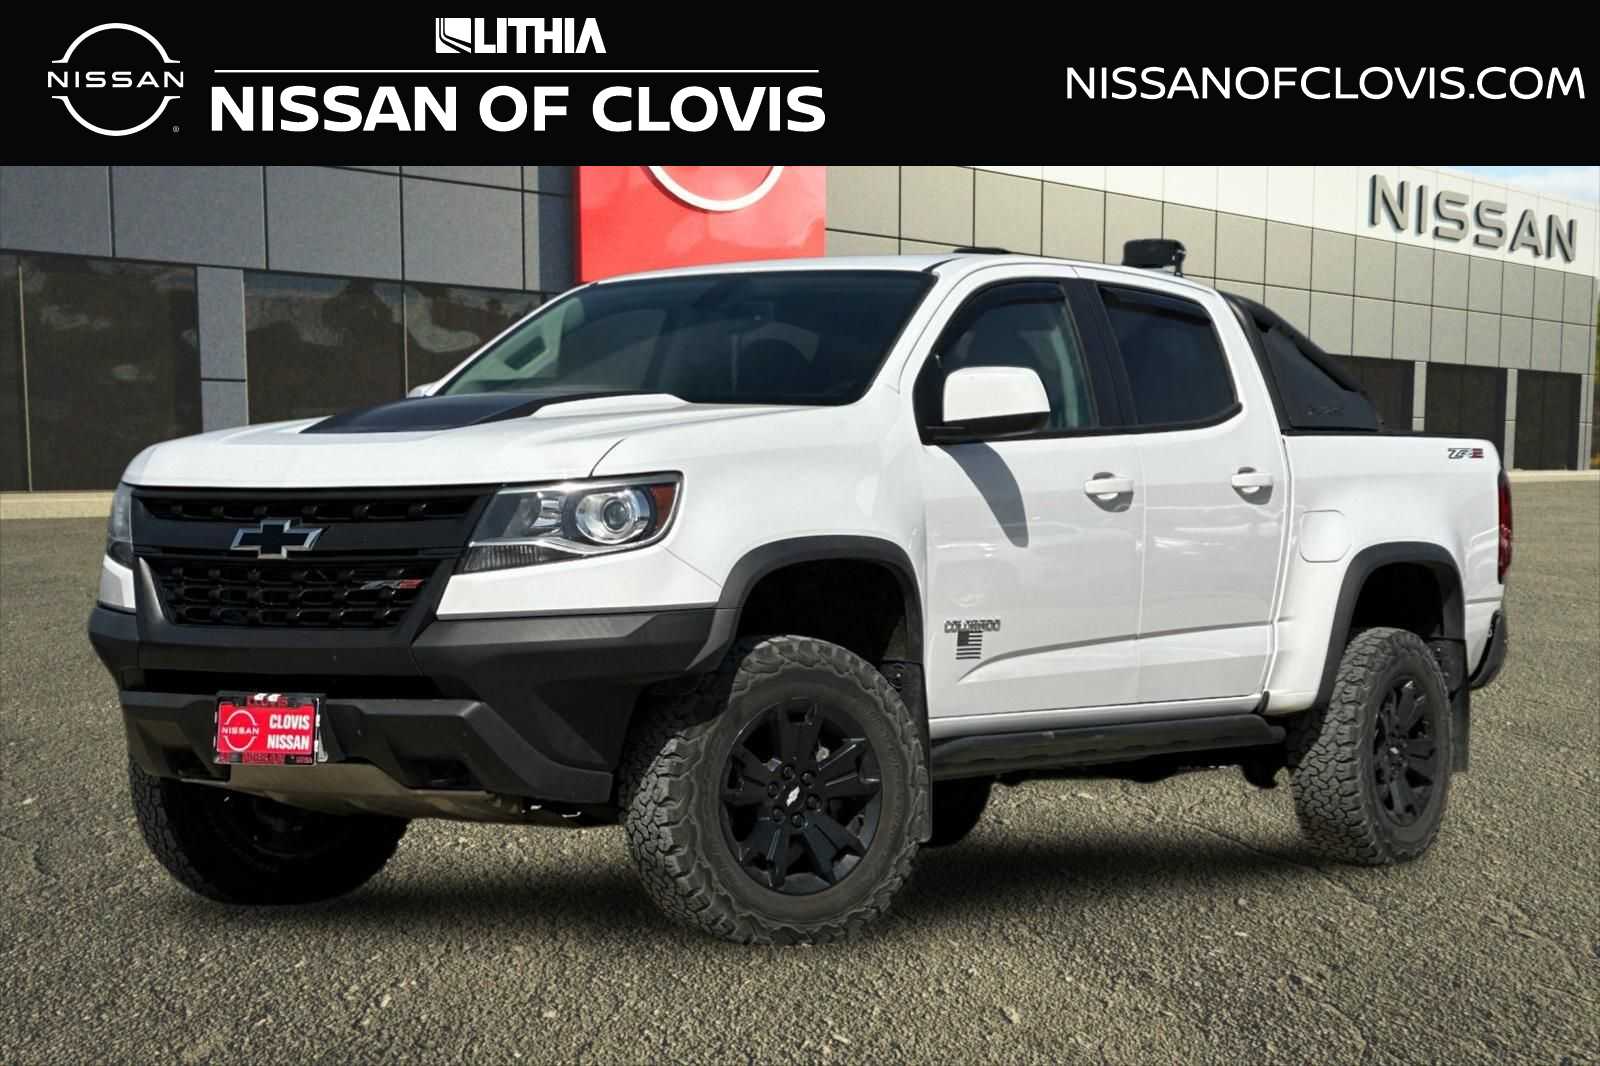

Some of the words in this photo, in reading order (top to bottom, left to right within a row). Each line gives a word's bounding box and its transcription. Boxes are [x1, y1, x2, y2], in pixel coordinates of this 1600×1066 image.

[1369, 174, 1577, 263] NISSAN
[221, 726, 259, 735] NISSAN
[269, 714, 310, 731] CLOVIS
[267, 734, 311, 750] NISSAN
